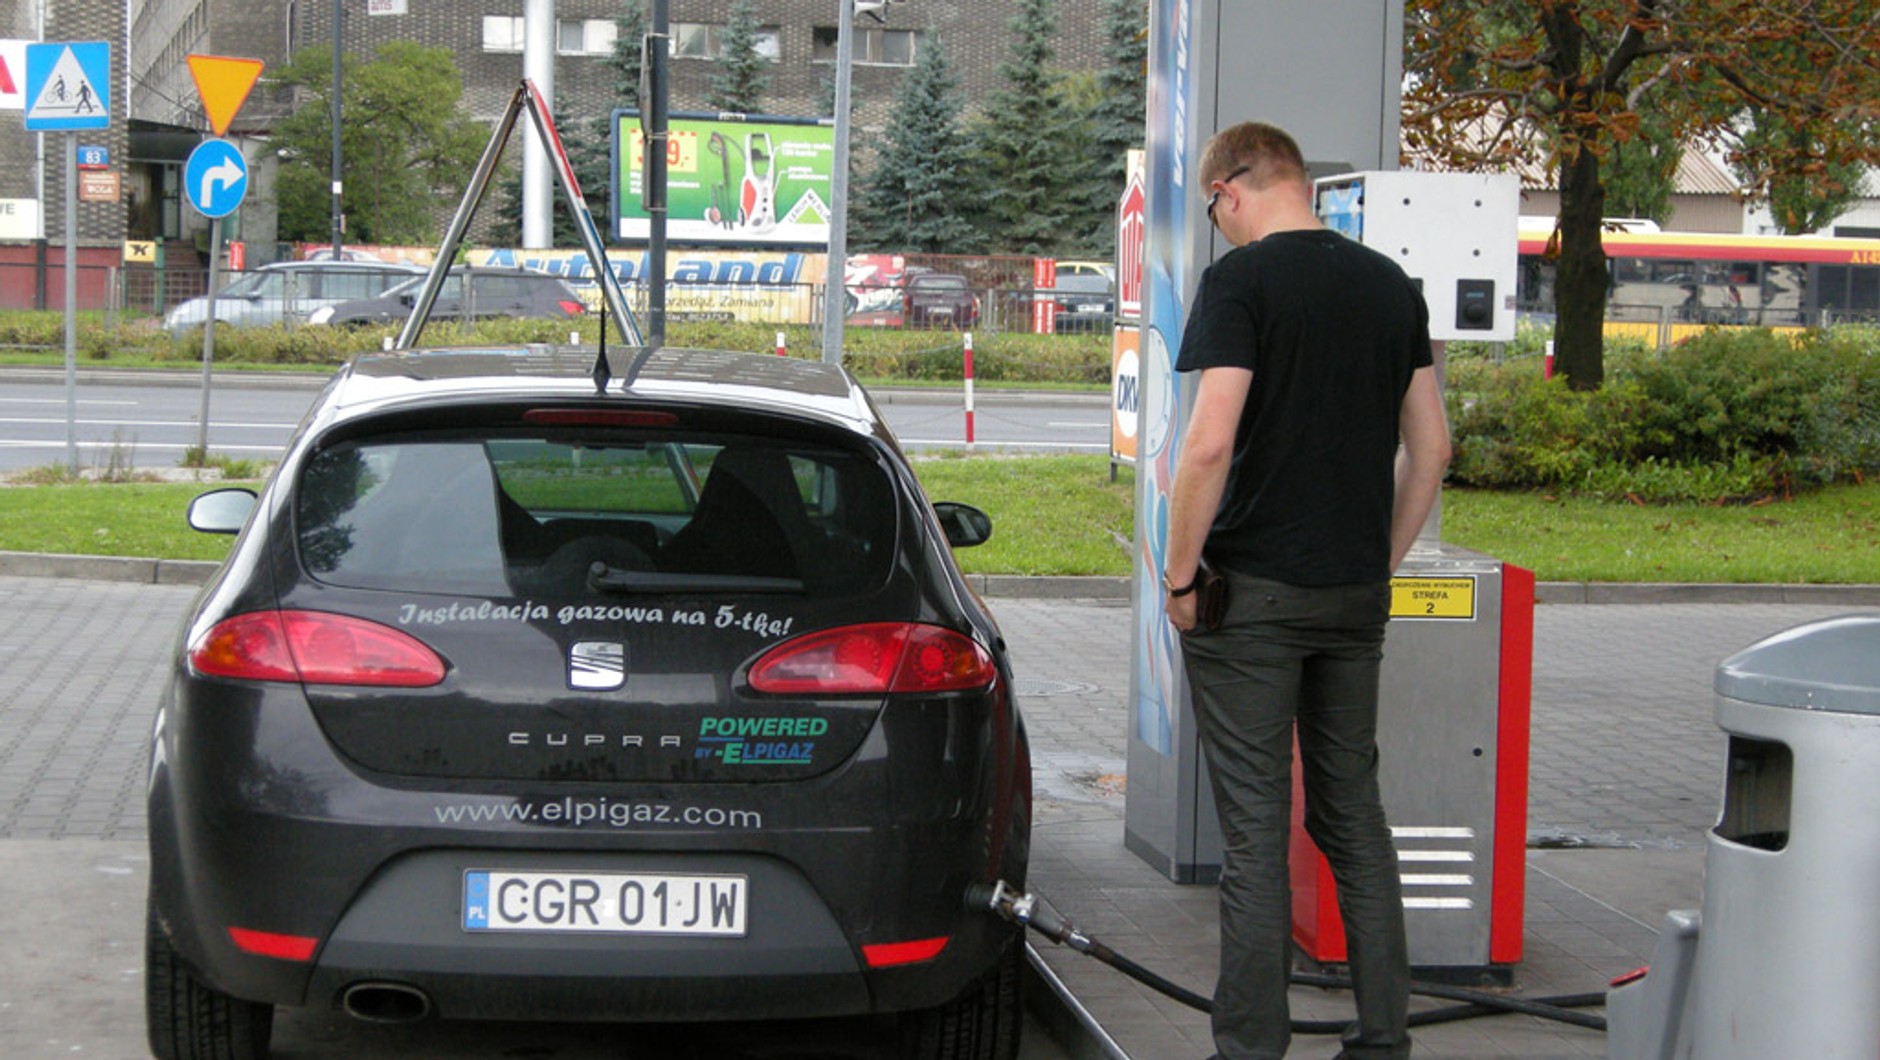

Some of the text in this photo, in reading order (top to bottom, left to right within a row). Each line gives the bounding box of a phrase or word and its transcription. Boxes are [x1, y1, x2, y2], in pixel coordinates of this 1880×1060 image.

[85, 150, 102, 164] 83
[1412, 592, 1448, 600] STREFA
[398, 600, 550, 625] Instalacja
[557, 604, 664, 625] gazowa
[671, 609, 706, 626] na
[1426, 602, 1435, 614] 2
[699, 717, 829, 737] POWERED
[507, 732, 682, 748] CUPRA
[694, 747, 713, 759] BY
[434, 797, 763, 829] www.elpigaz.com
[497, 878, 601, 926] CGR
[468, 906, 486, 920] PL
